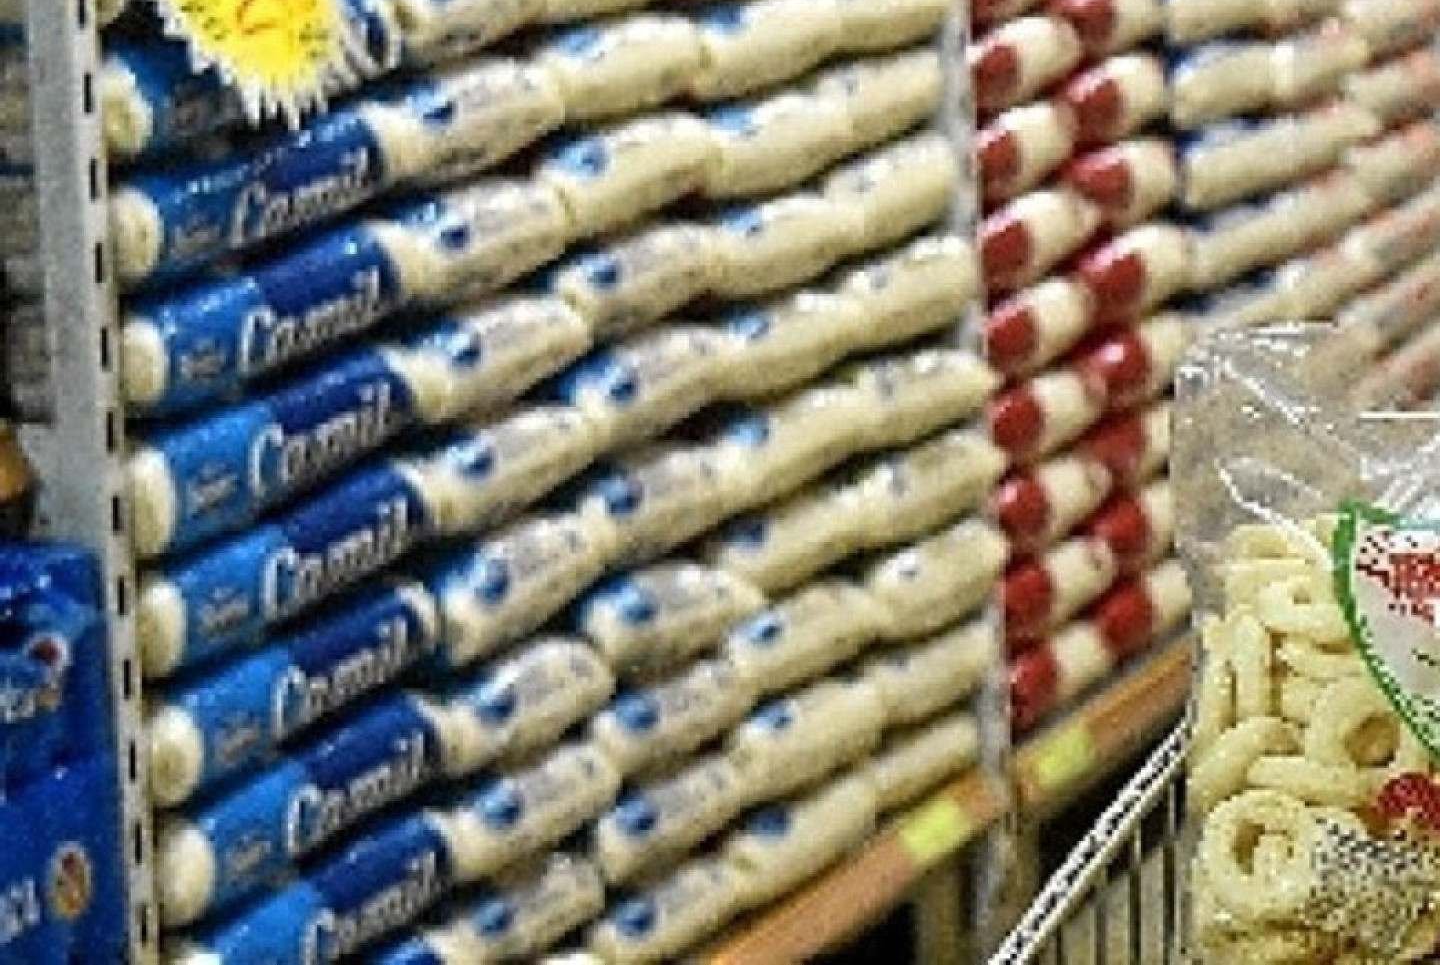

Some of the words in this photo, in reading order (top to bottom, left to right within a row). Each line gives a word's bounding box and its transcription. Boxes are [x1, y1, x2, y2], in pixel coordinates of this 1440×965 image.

[231, 147, 371, 248] Camil
[240, 267, 380, 372] Camil
[250, 383, 392, 494] Camil
[263, 496, 408, 618] Camil
[273, 618, 409, 739] Camil
[287, 732, 425, 856] Camil
